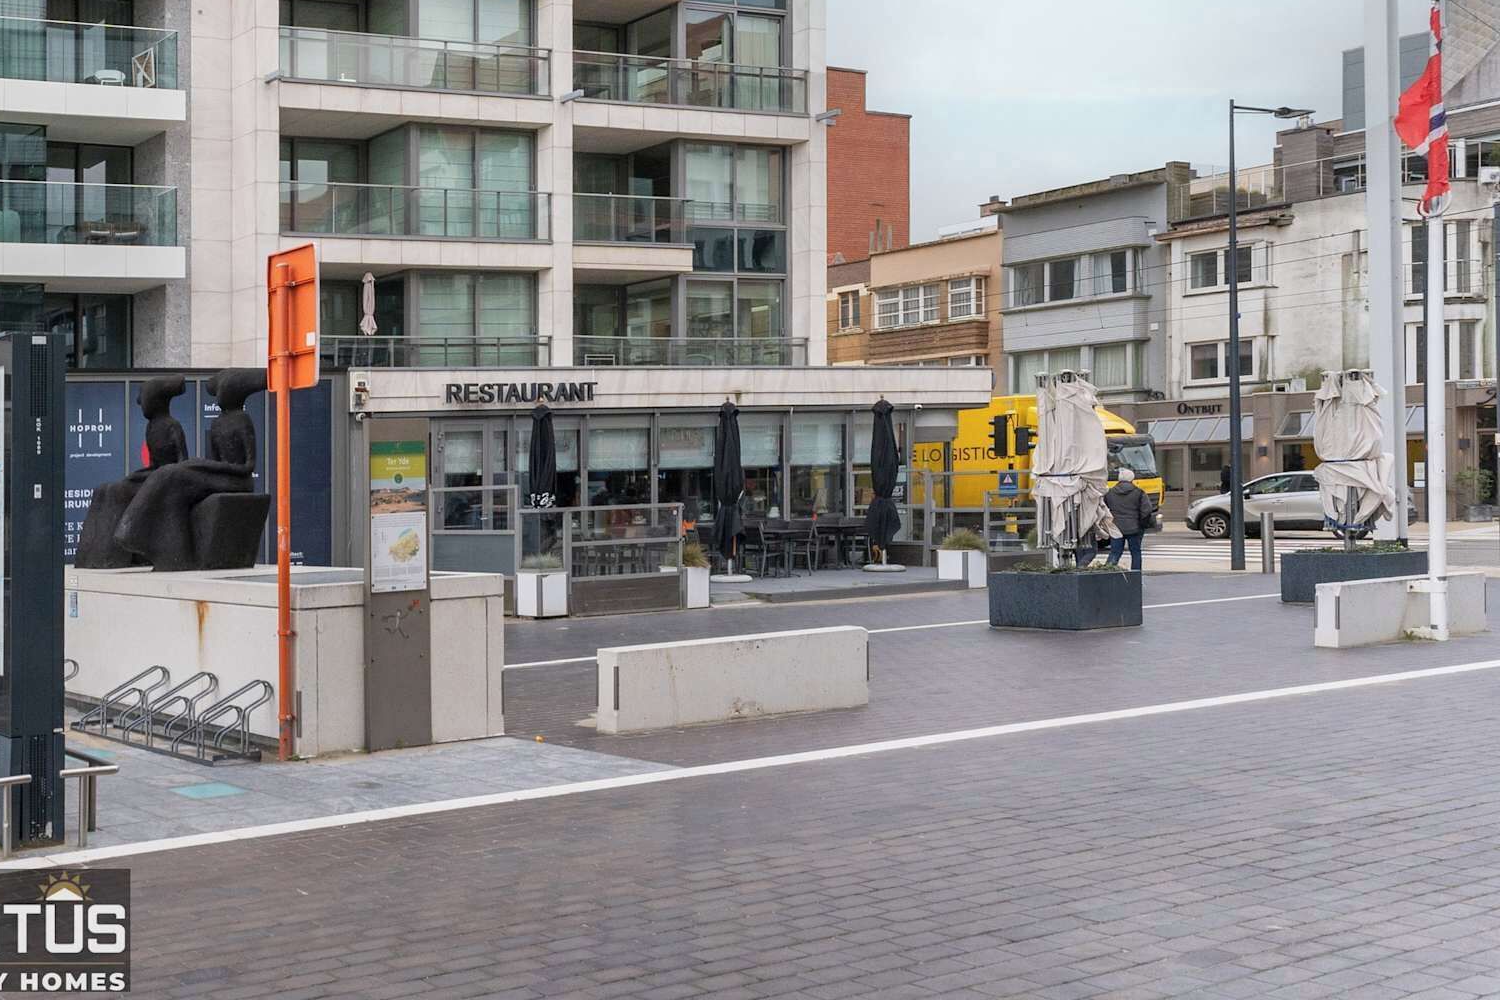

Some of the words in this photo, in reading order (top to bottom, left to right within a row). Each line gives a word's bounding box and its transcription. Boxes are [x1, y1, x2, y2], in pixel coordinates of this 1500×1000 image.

[445, 382, 598, 404] RESTAURANT
[69, 424, 112, 433] HOPROM
[65, 489, 94, 498] ESID
